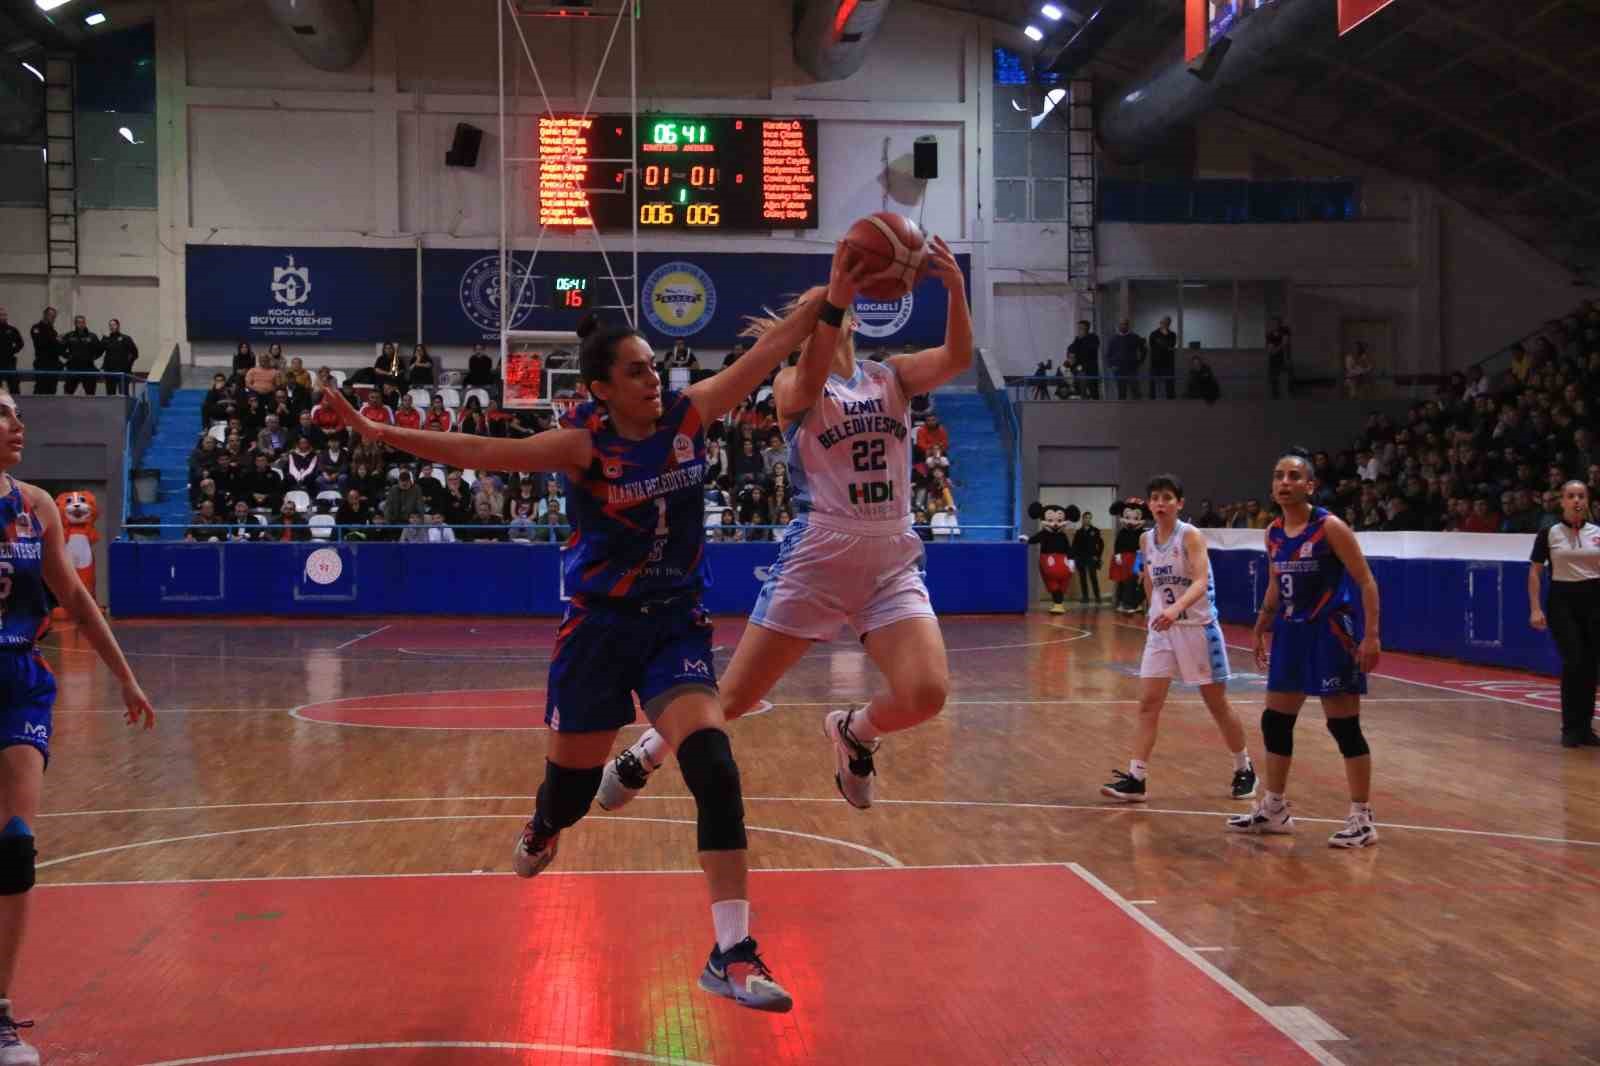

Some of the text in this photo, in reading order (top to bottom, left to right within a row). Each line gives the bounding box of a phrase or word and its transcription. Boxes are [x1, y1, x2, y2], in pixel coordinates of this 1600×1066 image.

[645, 165, 669, 186] 01
[690, 165, 715, 186] 01
[640, 204, 674, 224] 006
[686, 204, 720, 224] 005
[564, 290, 583, 307] 16
[852, 438, 887, 471] 22
[848, 480, 893, 504] HDI
[654, 497, 669, 535] 1
[1163, 587, 1176, 605] 3
[1281, 573, 1294, 598] 3
